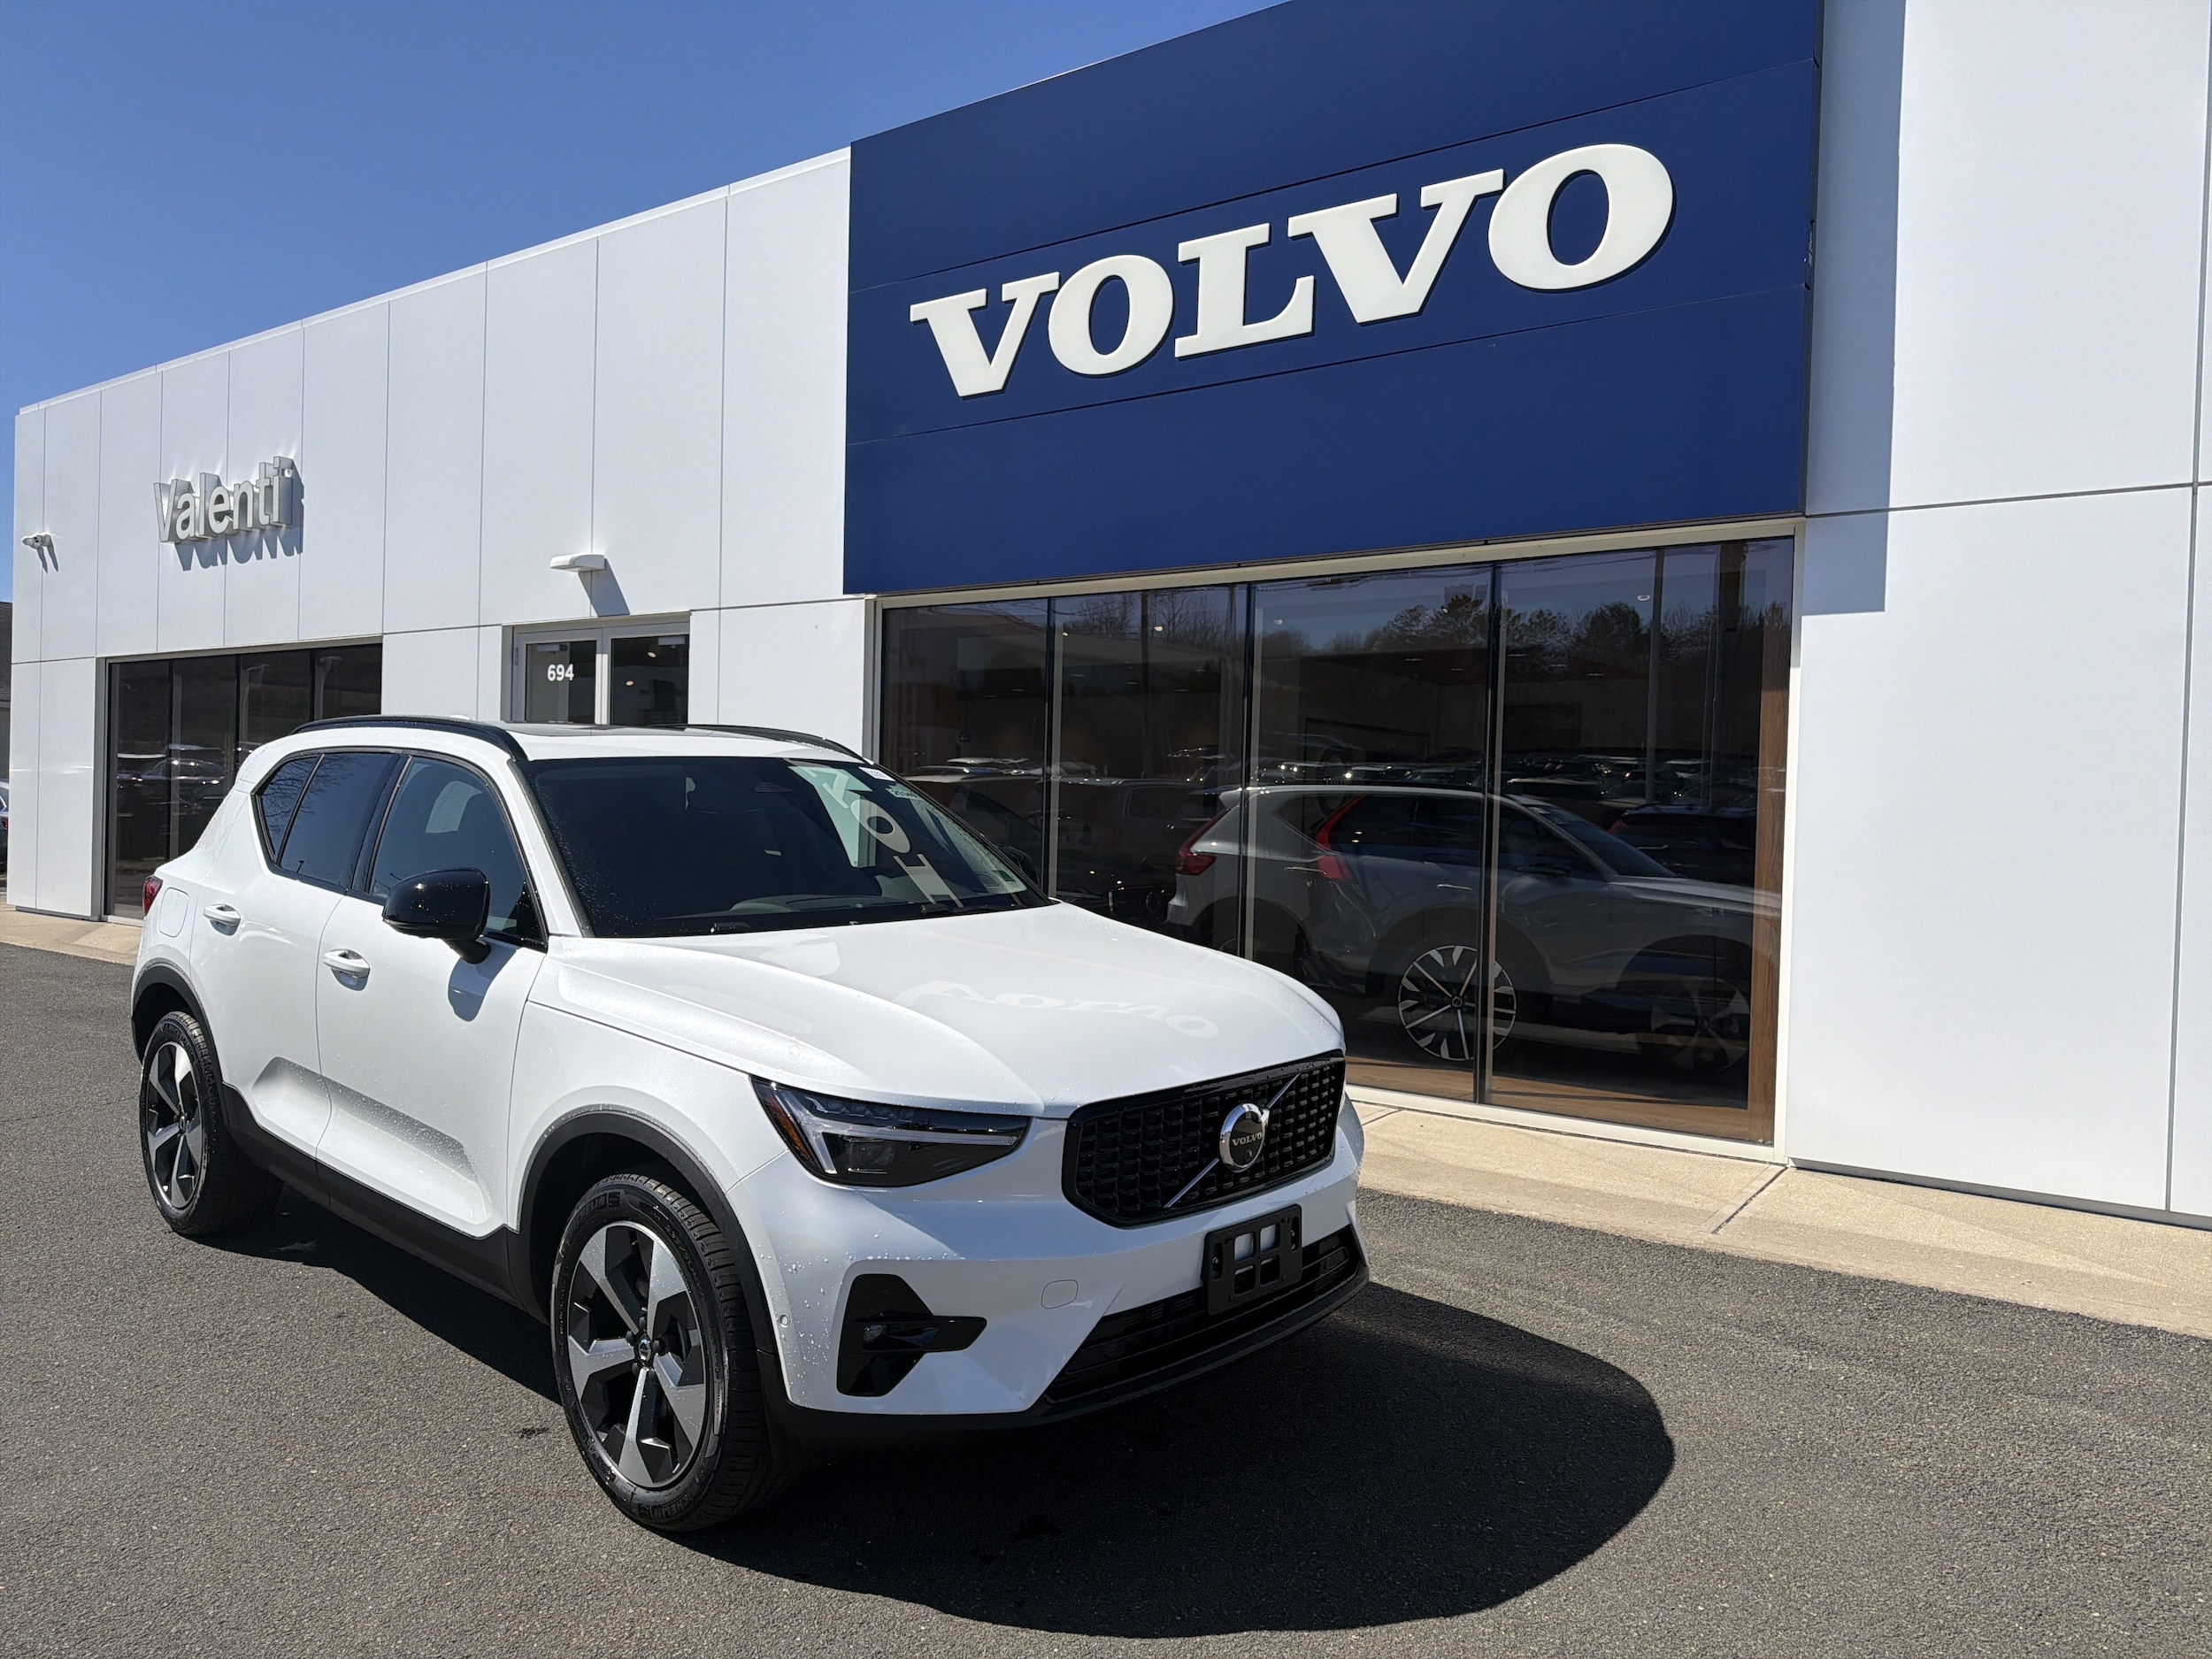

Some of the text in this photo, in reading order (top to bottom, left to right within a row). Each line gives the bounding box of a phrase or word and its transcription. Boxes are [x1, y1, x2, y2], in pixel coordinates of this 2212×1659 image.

[910, 143, 1674, 396] VOLVO
[153, 456, 281, 542] Valenti
[547, 664, 574, 681] 694
[1232, 1132, 1263, 1147] VOLVO
